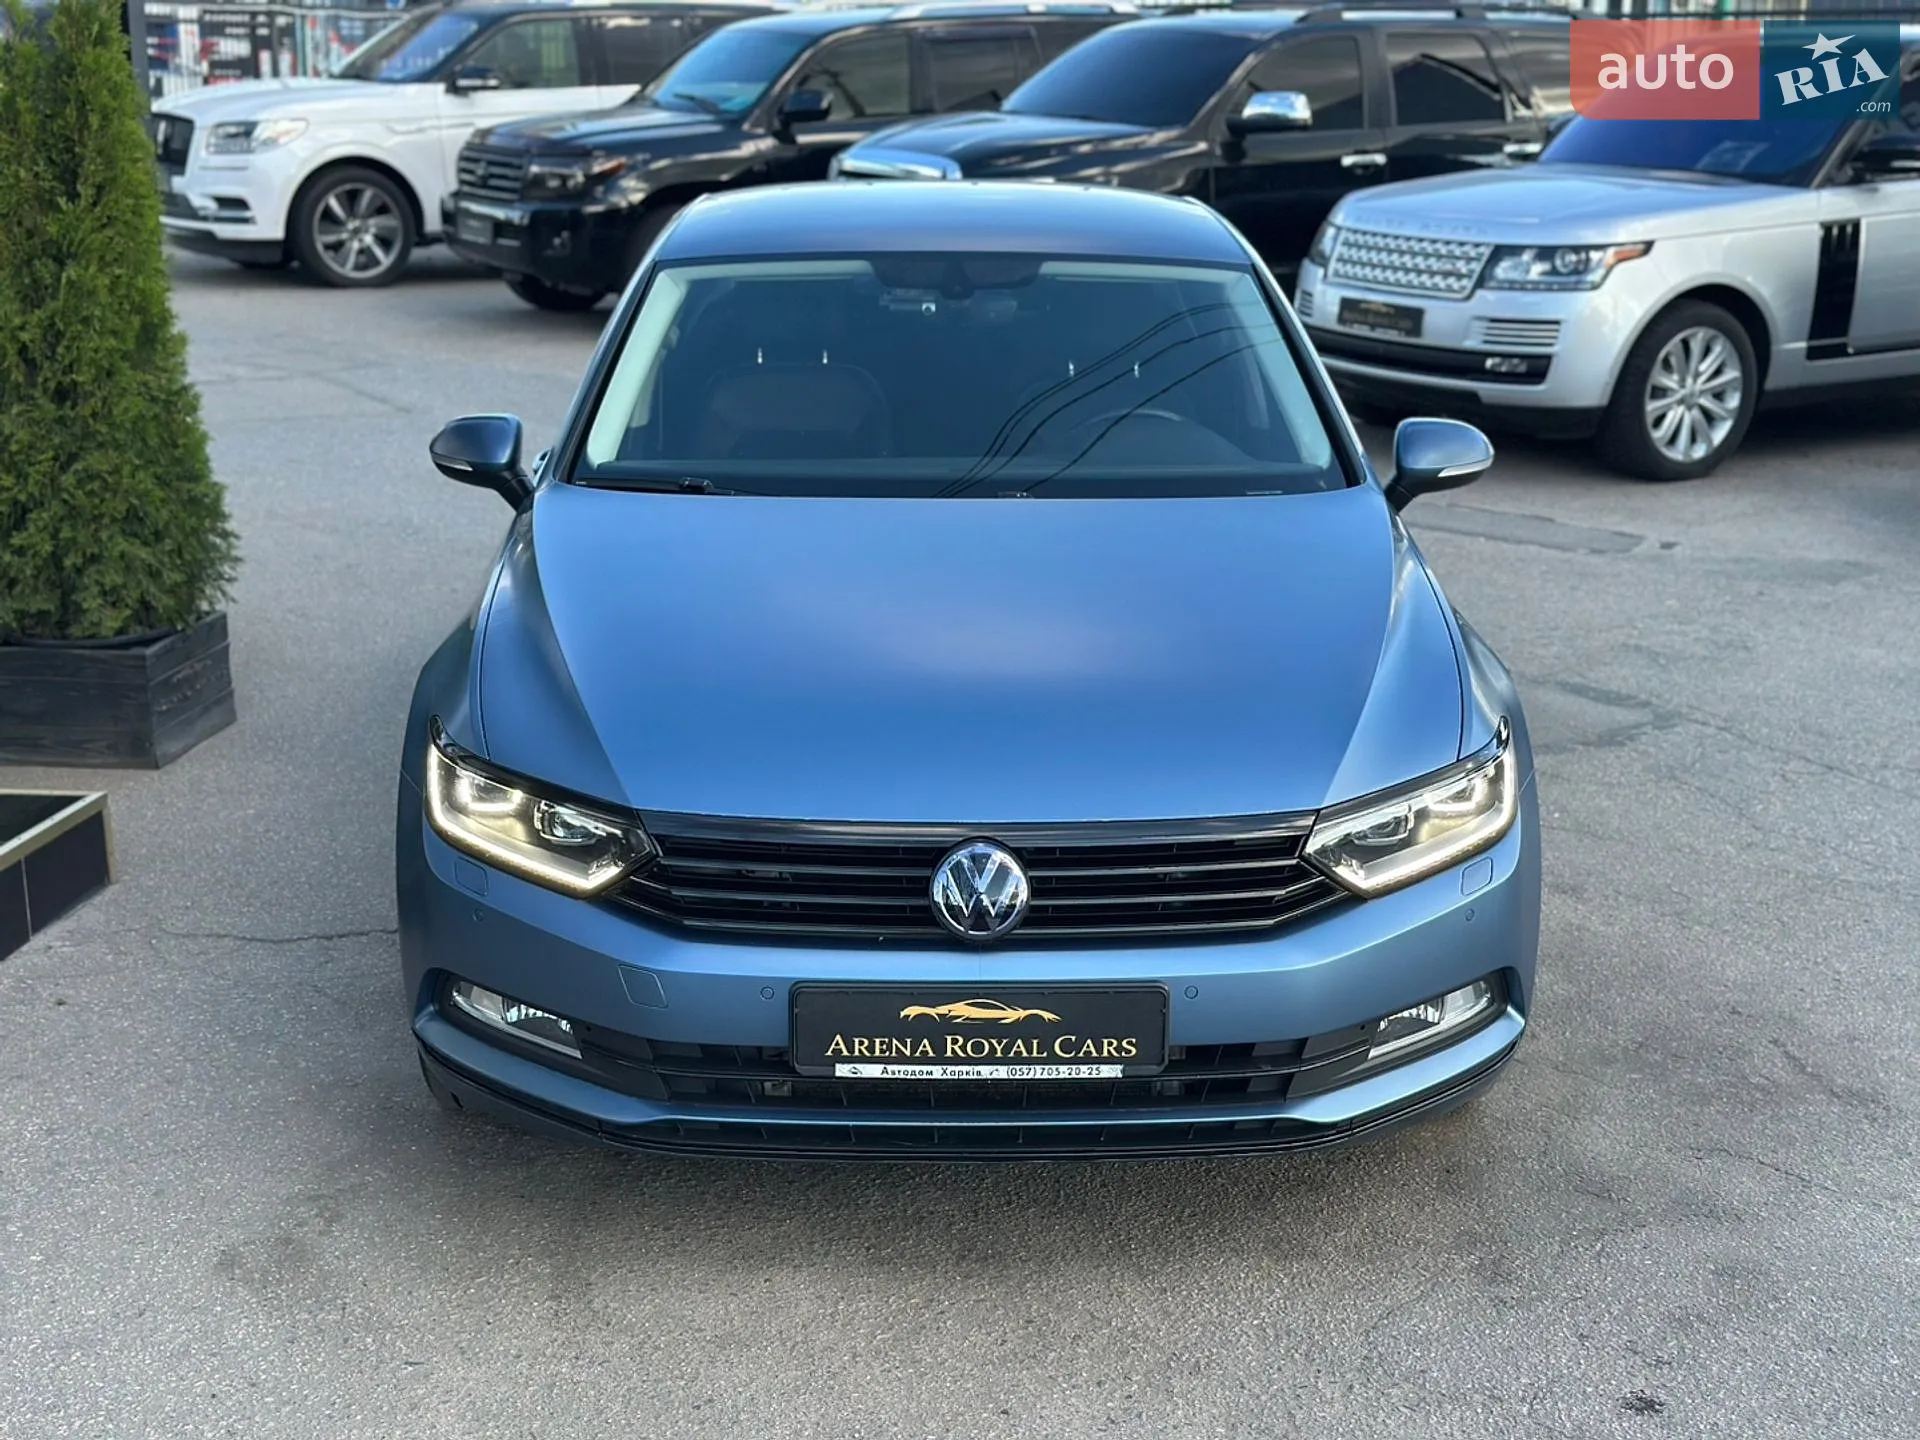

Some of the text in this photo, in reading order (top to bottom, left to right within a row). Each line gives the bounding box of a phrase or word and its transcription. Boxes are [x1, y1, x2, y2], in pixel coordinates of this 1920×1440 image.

[825, 1034, 1138, 1057] ARENA ROYAL CARS
[880, 1066, 934, 1077] Автодом
